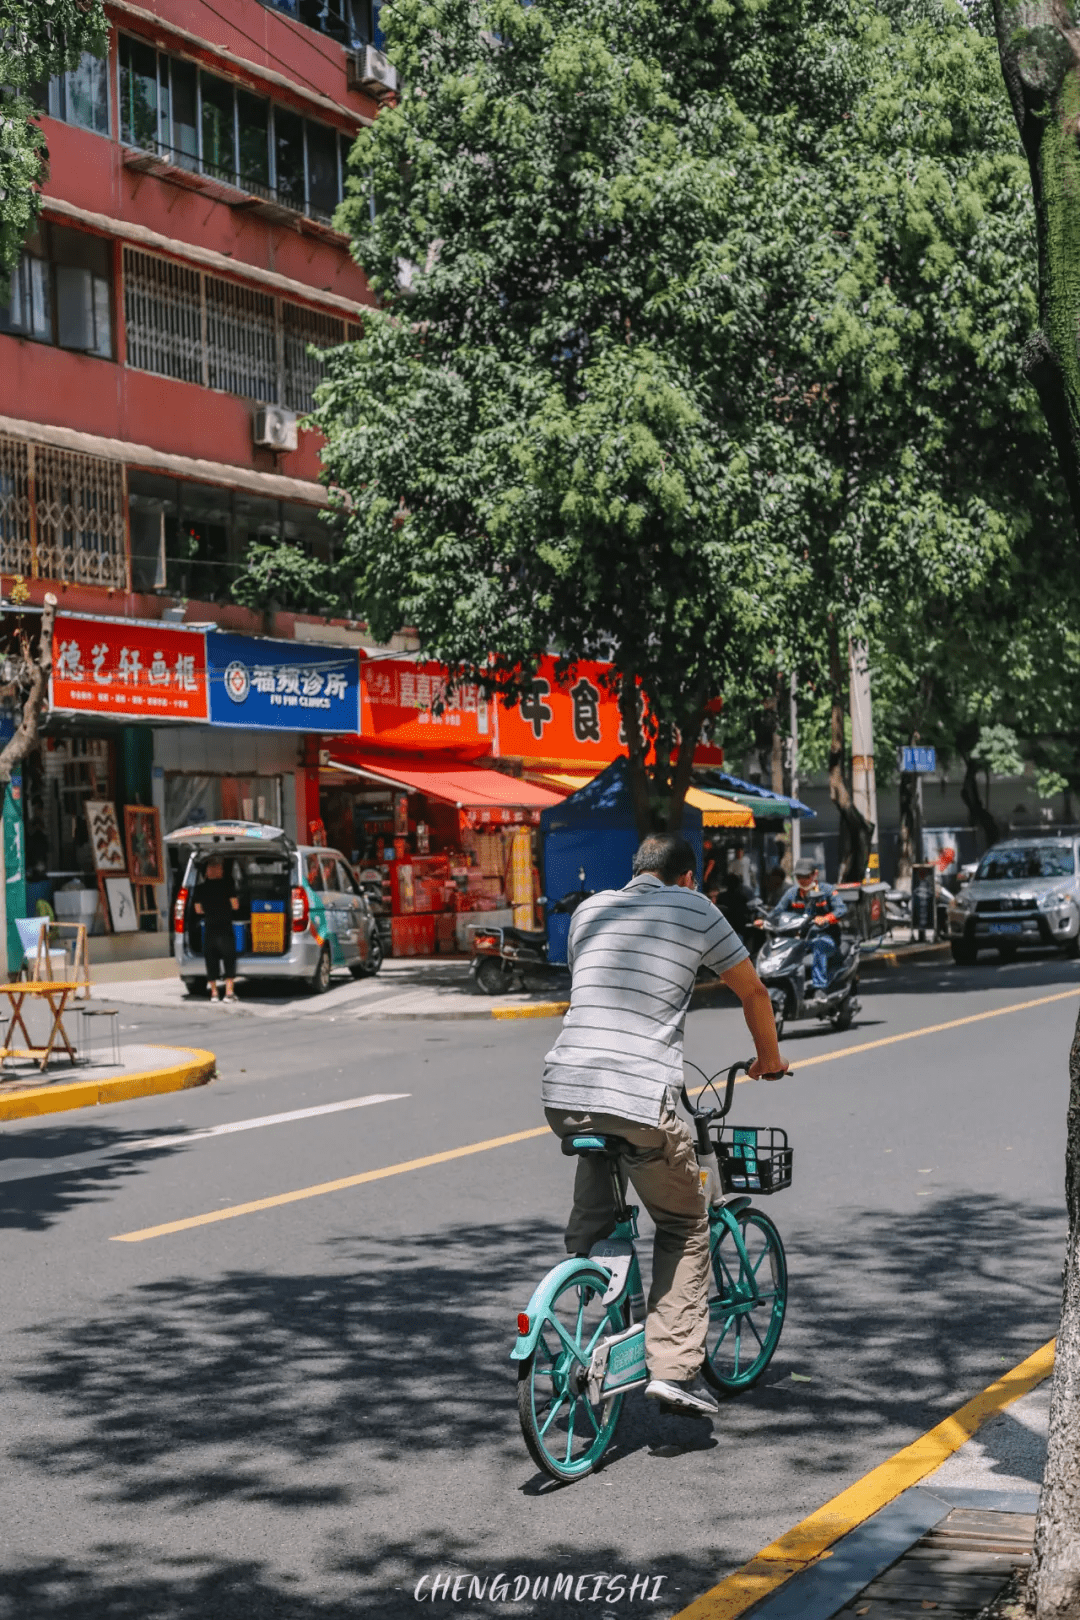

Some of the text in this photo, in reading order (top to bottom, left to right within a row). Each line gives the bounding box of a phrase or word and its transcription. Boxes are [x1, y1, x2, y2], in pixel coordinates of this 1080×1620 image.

[56, 639, 199, 691] 德艺轩画框
[251, 664, 348, 700] 福频诊所
[270, 694, 282, 705] FU
[283, 695, 298, 706] PIN
